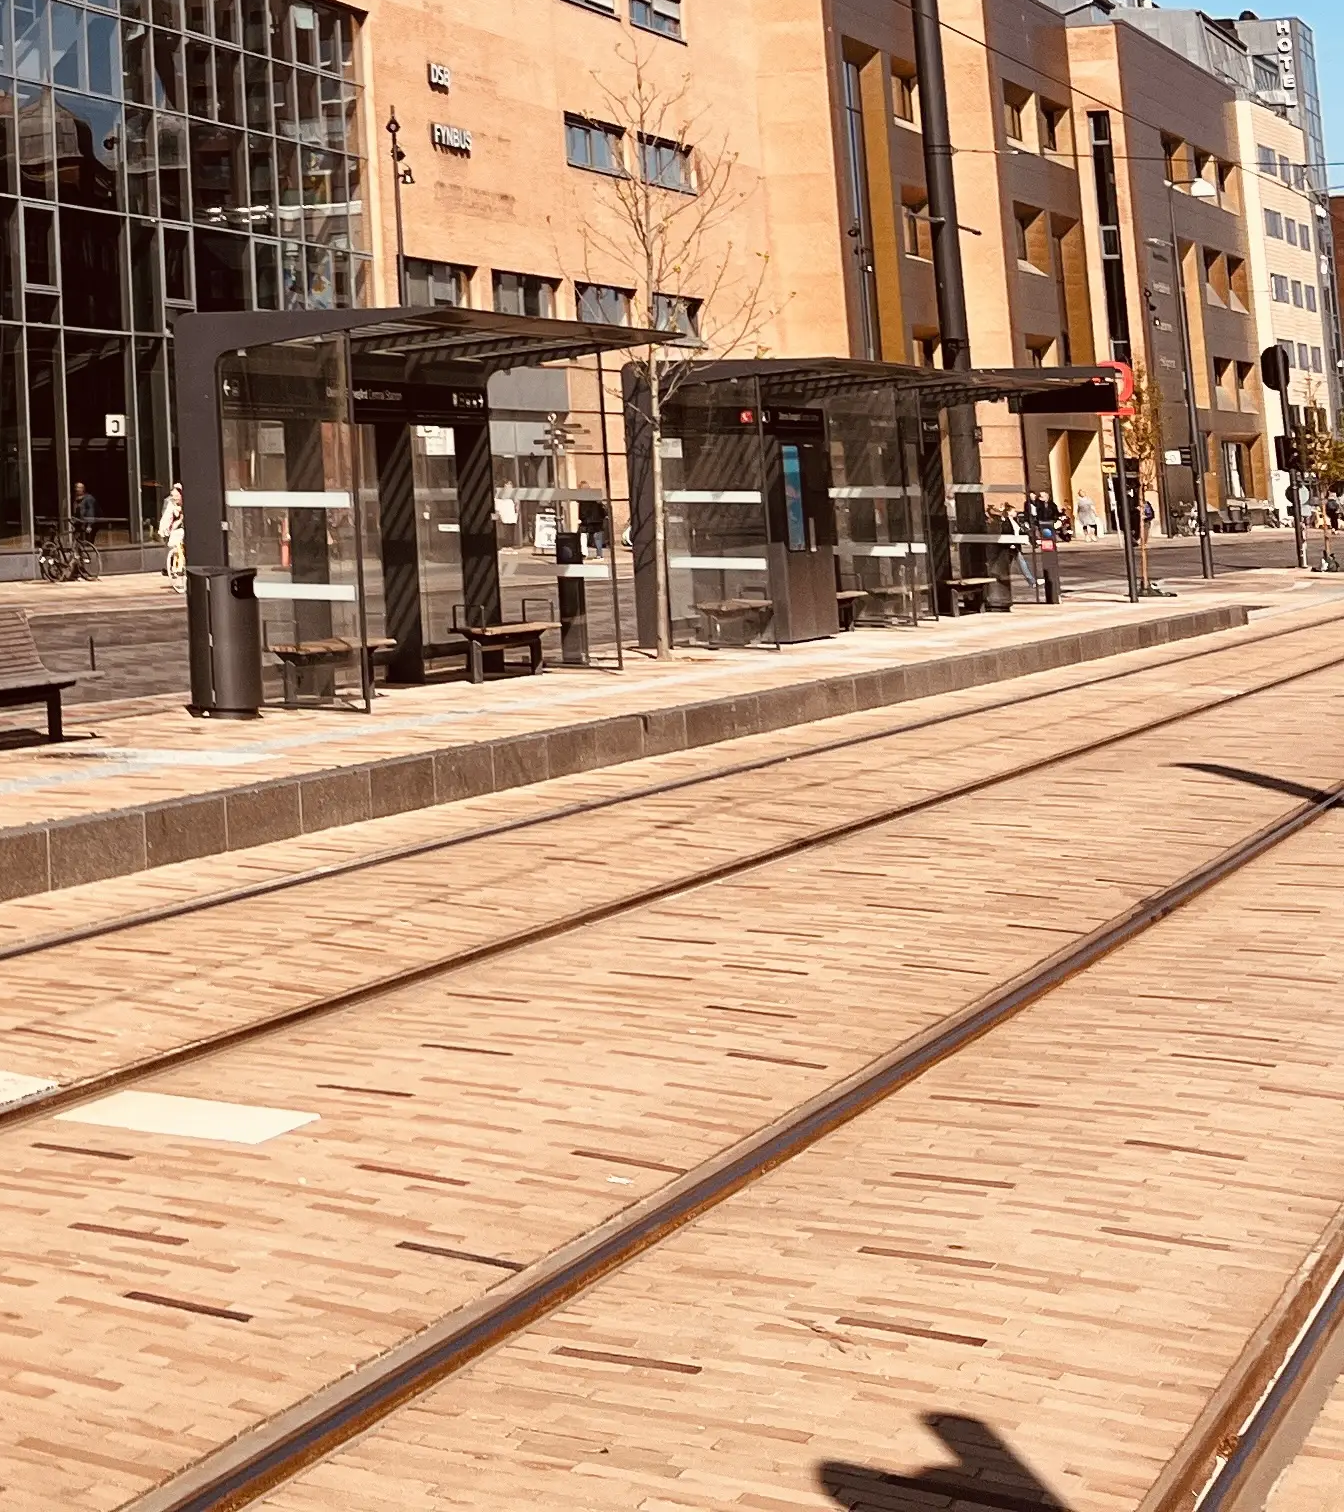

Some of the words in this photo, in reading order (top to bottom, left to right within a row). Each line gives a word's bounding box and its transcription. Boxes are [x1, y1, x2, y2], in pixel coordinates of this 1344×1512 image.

[430, 62, 451, 87] DSB
[1276, 19, 1298, 106] HOTEL
[433, 122, 472, 151] FYNBUS
